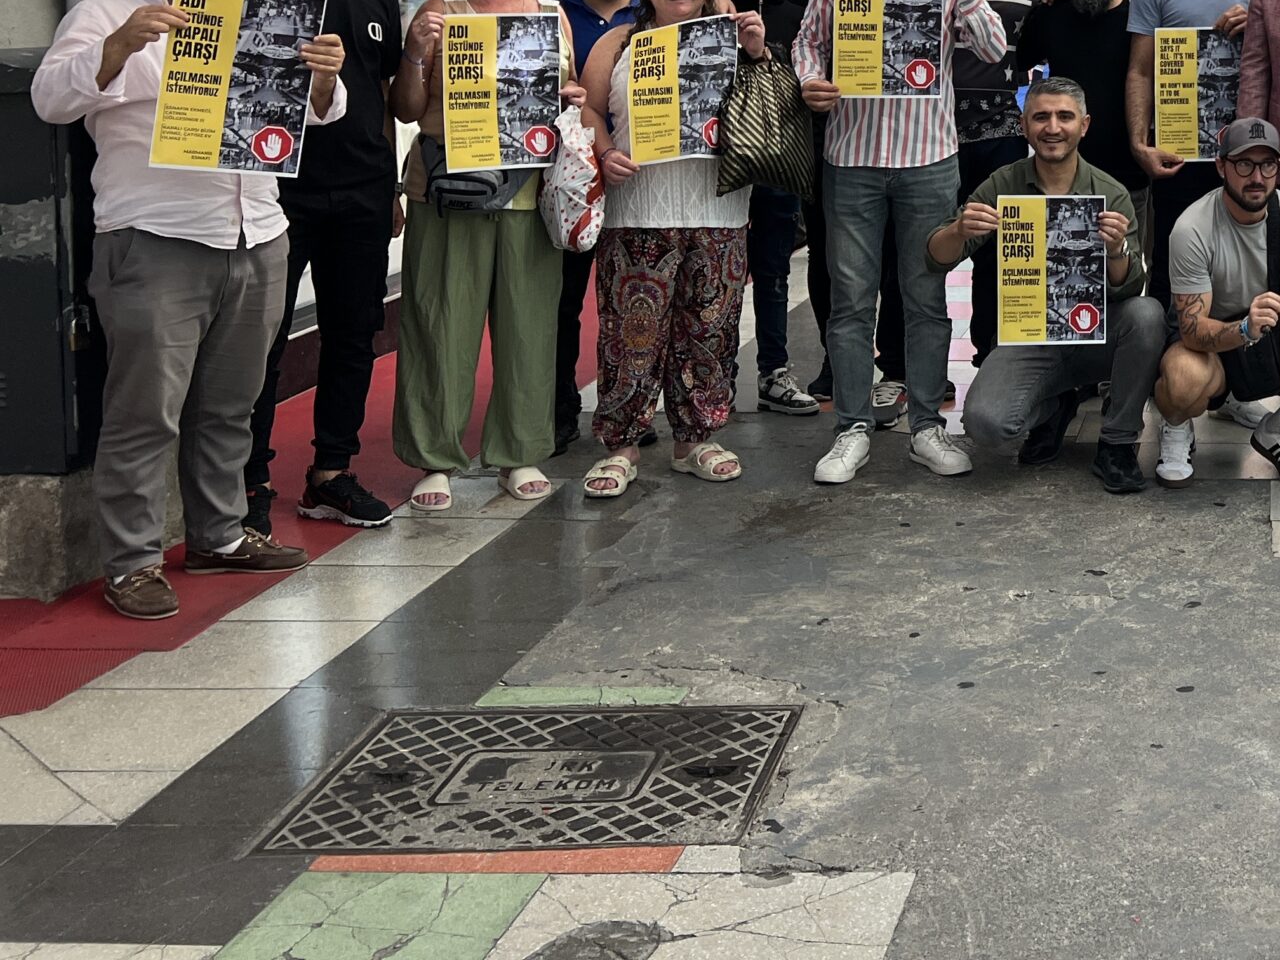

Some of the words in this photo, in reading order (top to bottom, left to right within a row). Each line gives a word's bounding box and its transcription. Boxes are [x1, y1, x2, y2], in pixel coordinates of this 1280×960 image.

[839, 0, 872, 17] ÇARŞI
[181, 9, 224, 27] STÜNDE
[175, 26, 220, 42] KAPALI
[448, 25, 468, 39] ADI
[448, 41, 484, 52] ÜSTÜNDE
[635, 36, 653, 49] ADI
[1171, 37, 1187, 45] NAME
[172, 41, 218, 65] ÇARŞI
[635, 46, 666, 58] ÜSTÜNDE
[448, 53, 483, 65] KAPALI
[634, 55, 665, 68] KAPALI
[448, 66, 484, 85] ÇARŞI
[633, 64, 666, 83] ÇARŞI
[1002, 206, 1020, 219] ADI
[1002, 221, 1034, 232] ÜSTÜNDE
[1002, 233, 1034, 244] KAPALI
[1002, 245, 1034, 262] ÇARŞI
[478, 779, 617, 792] TELEKOM
